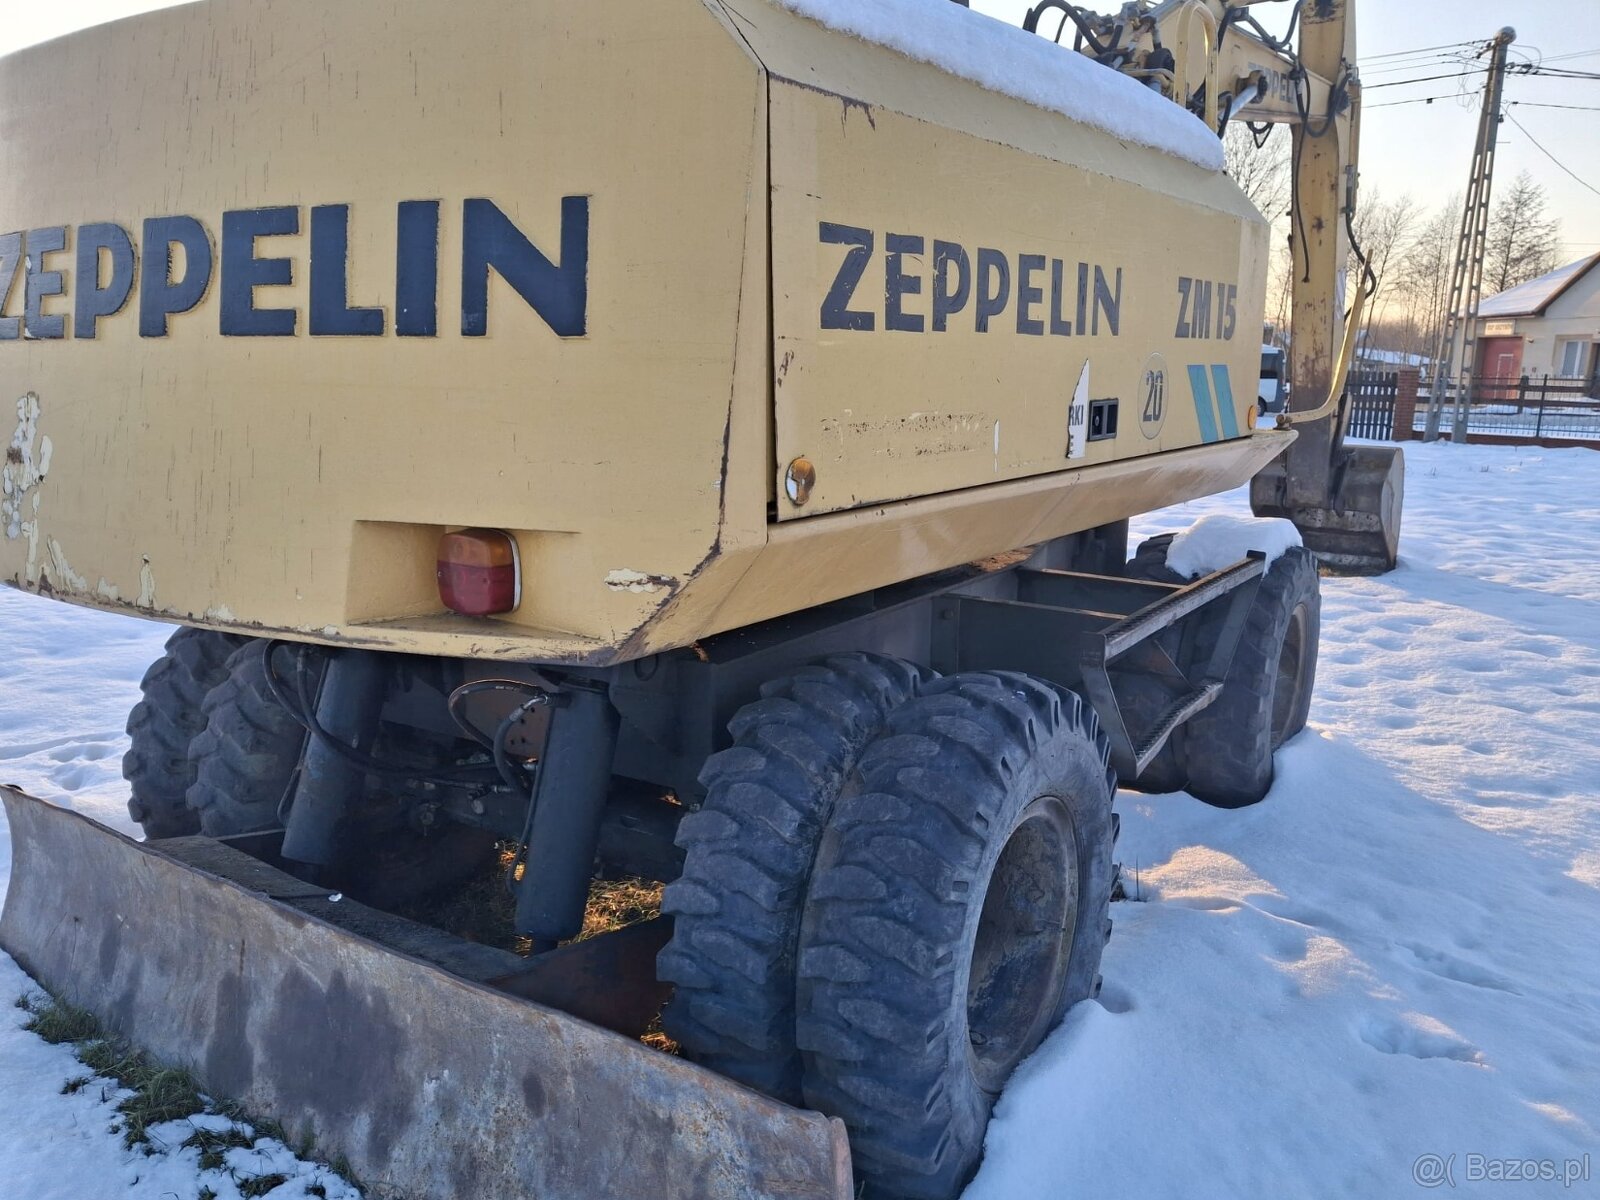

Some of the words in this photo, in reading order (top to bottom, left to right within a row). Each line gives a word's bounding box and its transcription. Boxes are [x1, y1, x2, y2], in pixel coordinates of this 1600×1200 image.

[0, 195, 590, 338] ZEPPELIN
[819, 221, 1122, 336] ZEPPELIN
[1175, 276, 1212, 339] ZM
[1216, 282, 1237, 340] 15
[1143, 370, 1163, 422] 20
